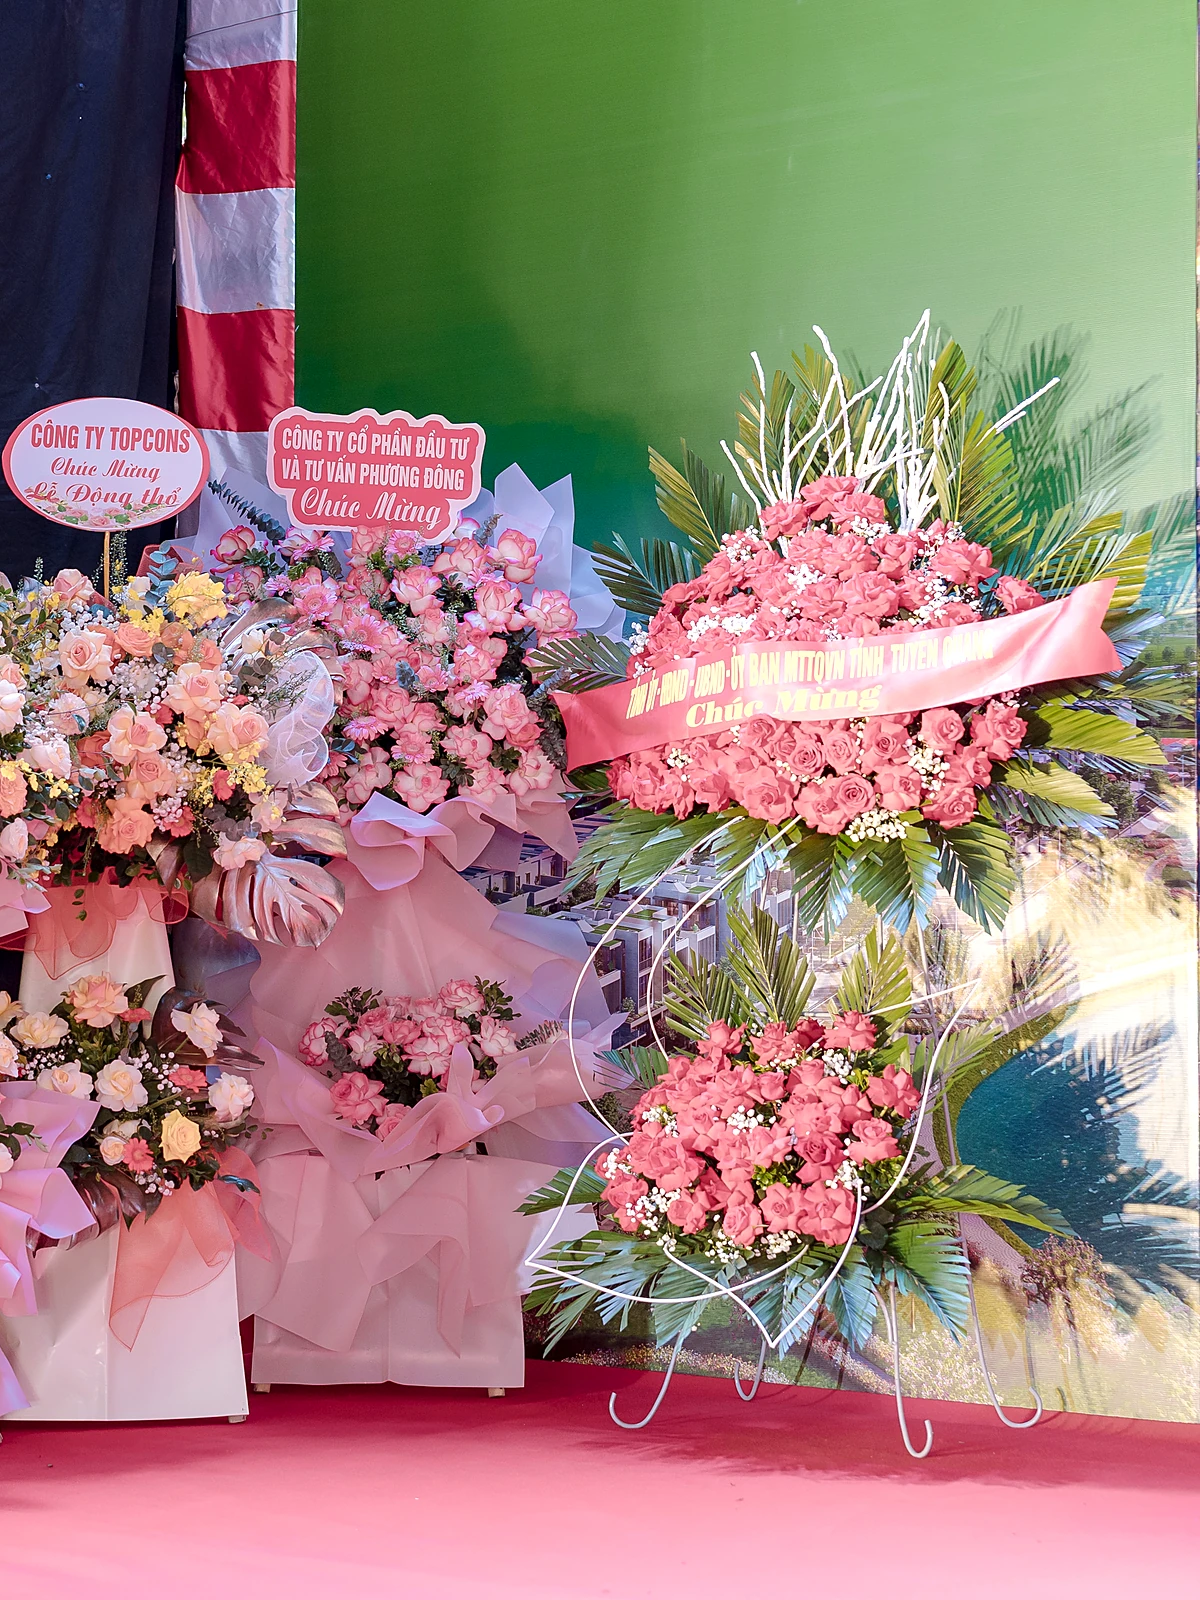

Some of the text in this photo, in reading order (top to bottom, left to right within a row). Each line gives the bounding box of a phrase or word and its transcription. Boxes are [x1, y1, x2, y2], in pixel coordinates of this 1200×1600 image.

[31, 419, 191, 453] CÔNG TY TOPCONS
[282, 424, 470, 460] CÔNG TY CỔ PHẦN ĐẦU TƯ
[50, 456, 160, 483] Chúc Mừng
[281, 454, 464, 491] VÀ TƯ VẤN PHƯƠNG ĐÔNG
[26, 482, 182, 507] Lễ Động thổ
[300, 486, 442, 531] Chúc Mừng
[749, 651, 780, 687] BAN
[784, 649, 846, 685] MTTQVN
[849, 638, 885, 679] TỈNH
[890, 633, 939, 674] TUYÊN
[685, 684, 883, 728] Chúc Mừng
